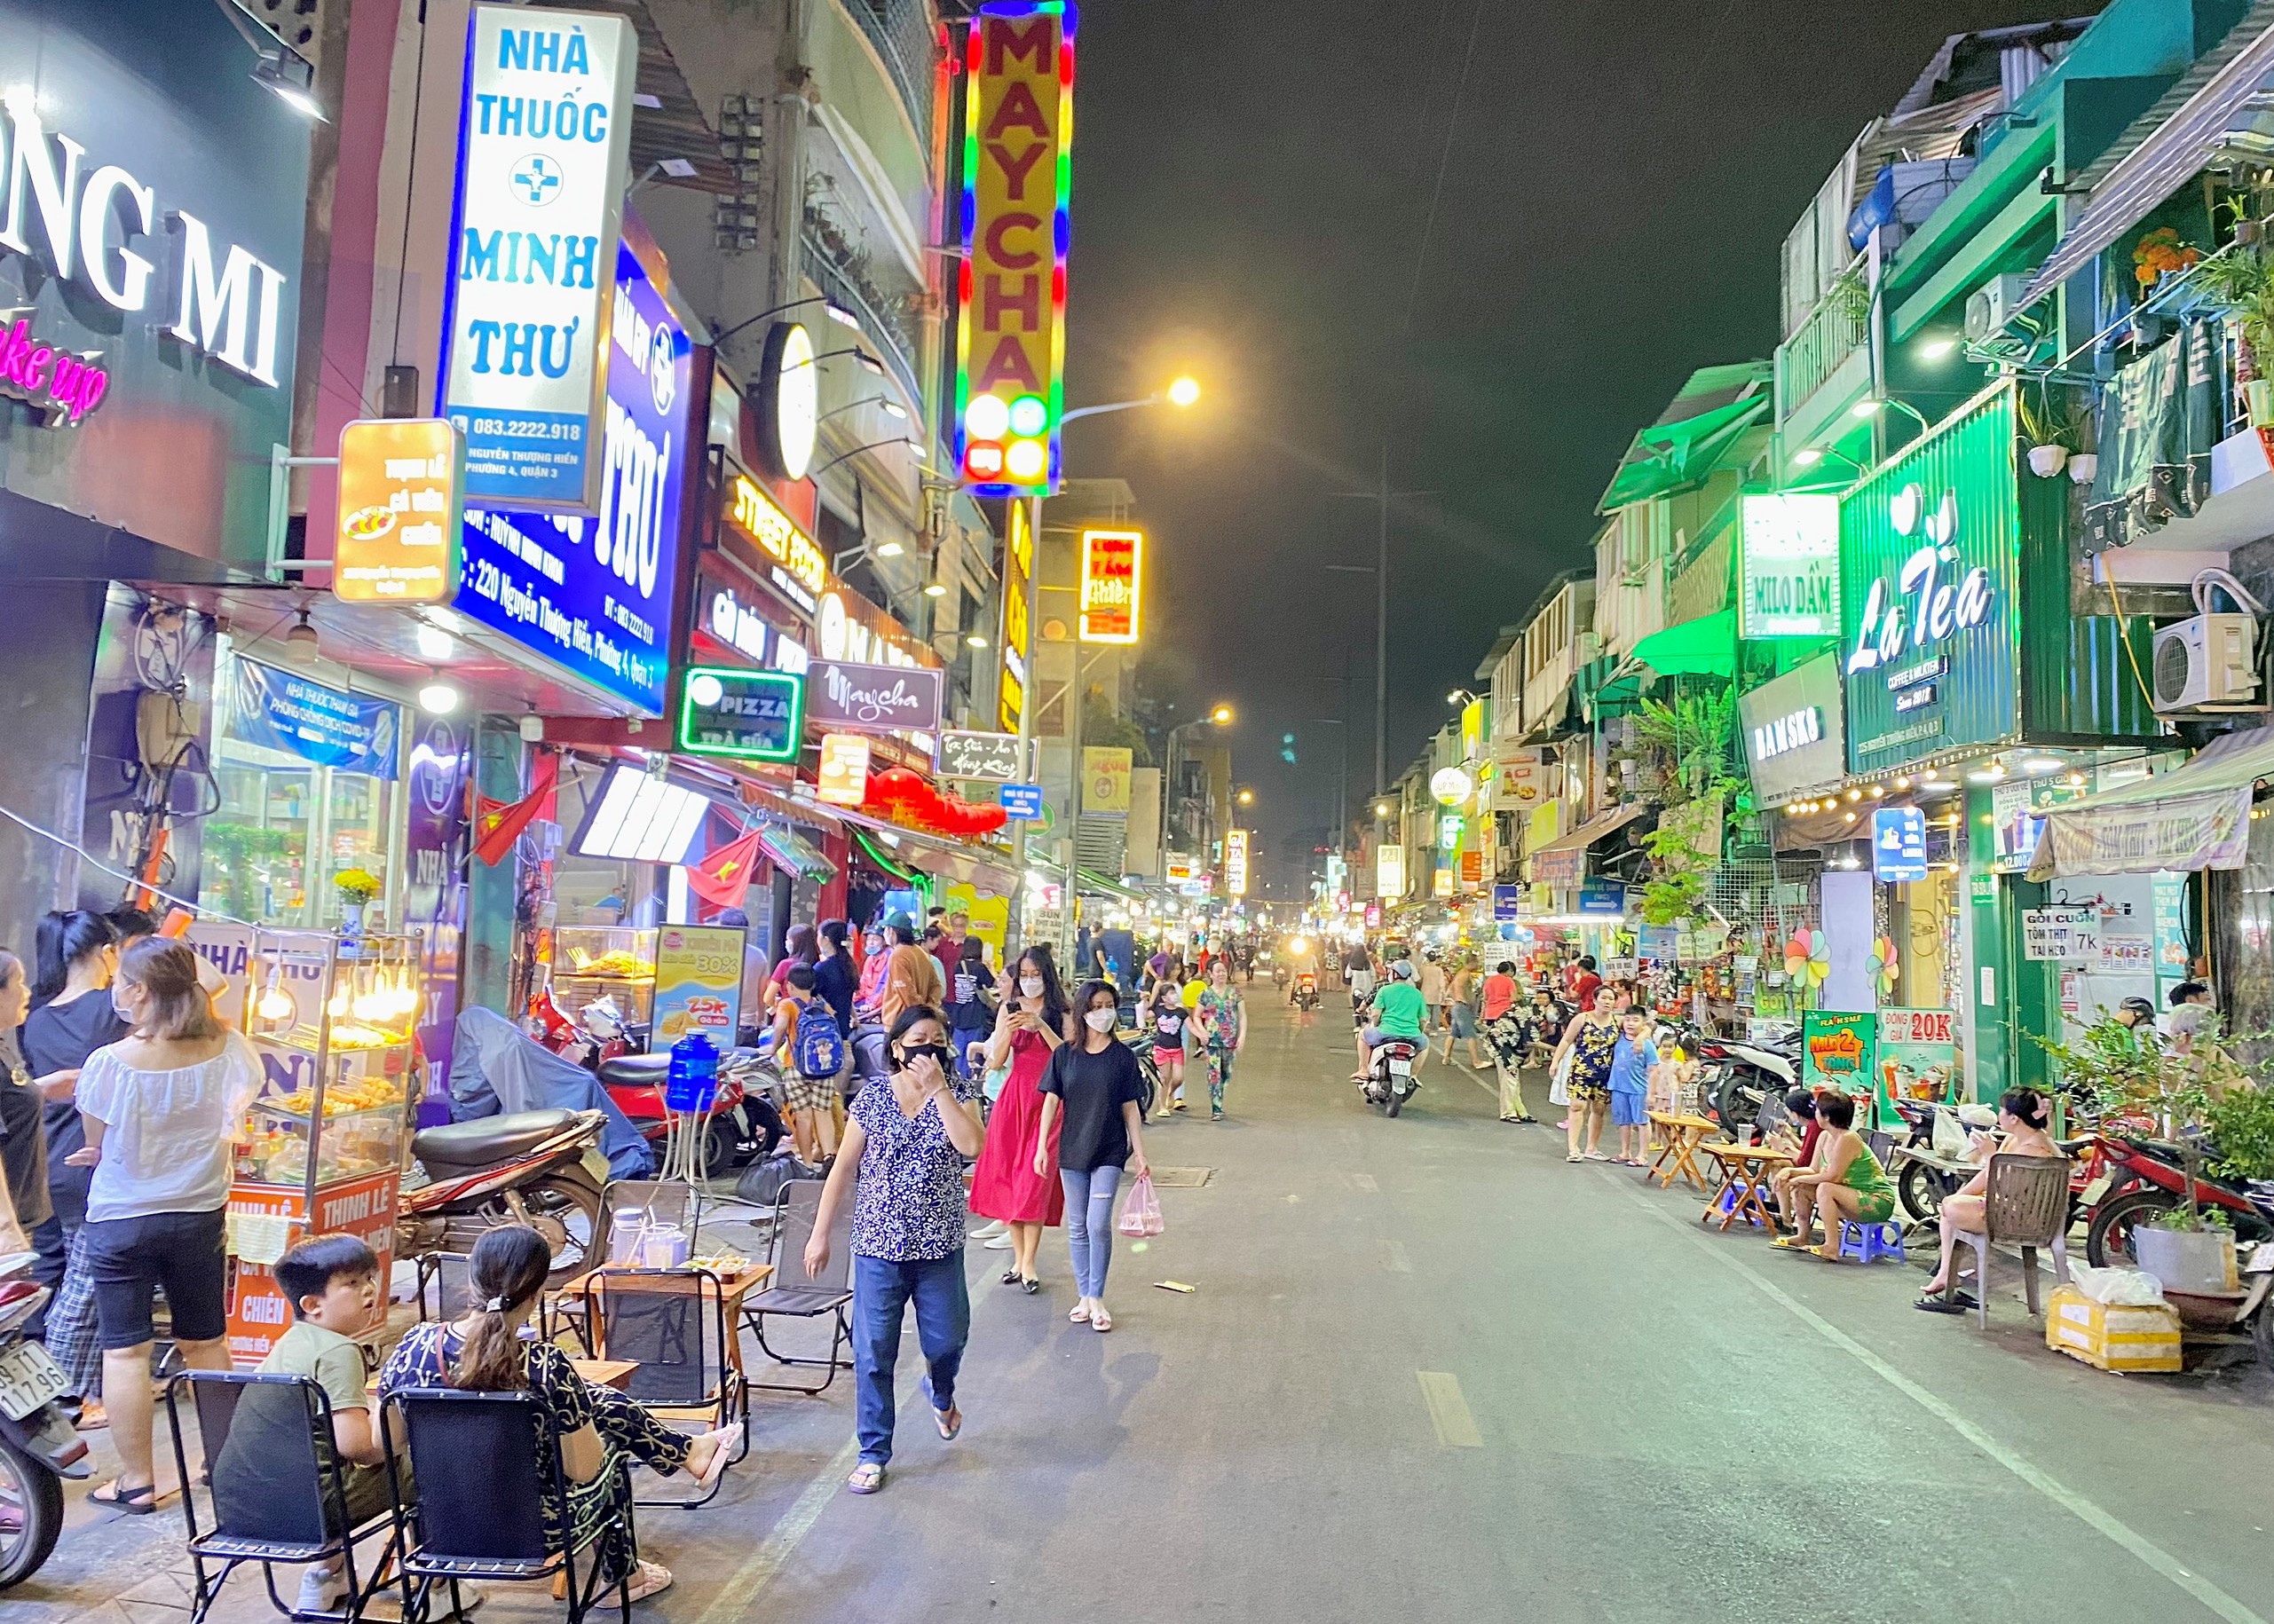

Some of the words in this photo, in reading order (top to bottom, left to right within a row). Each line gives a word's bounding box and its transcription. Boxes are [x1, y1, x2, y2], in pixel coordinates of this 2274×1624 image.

[498, 26, 589, 75] NHÀ
[477, 87, 608, 144] THUỐC
[978, 18, 1053, 392] MAYCHA
[0, 93, 154, 311] NG
[171, 209, 286, 389] MI
[461, 227, 598, 289] MINH
[469, 316, 580, 380] THƯ
[50, 353, 107, 422] up
[473, 418, 580, 441] 083.2222.918
[550, 467, 557, 477] 3
[1754, 575, 1791, 614] MILO
[1848, 578, 1907, 675] La
[1900, 546, 1991, 647] Tea
[475, 558, 500, 602] 220
[647, 665, 654, 689] 3
[286, 681, 304, 699] NHÀ
[720, 696, 790, 718] PIZZA
[824, 665, 919, 721] Maycha
[696, 955, 738, 975] 30%
[2076, 934, 2097, 950] 7k
[1840, 1028, 1855, 1052] 2
[1911, 1013, 1951, 1041] 20K
[241, 1292, 286, 1324] CHIÊN
[2, 1367, 65, 1415] 117.96
